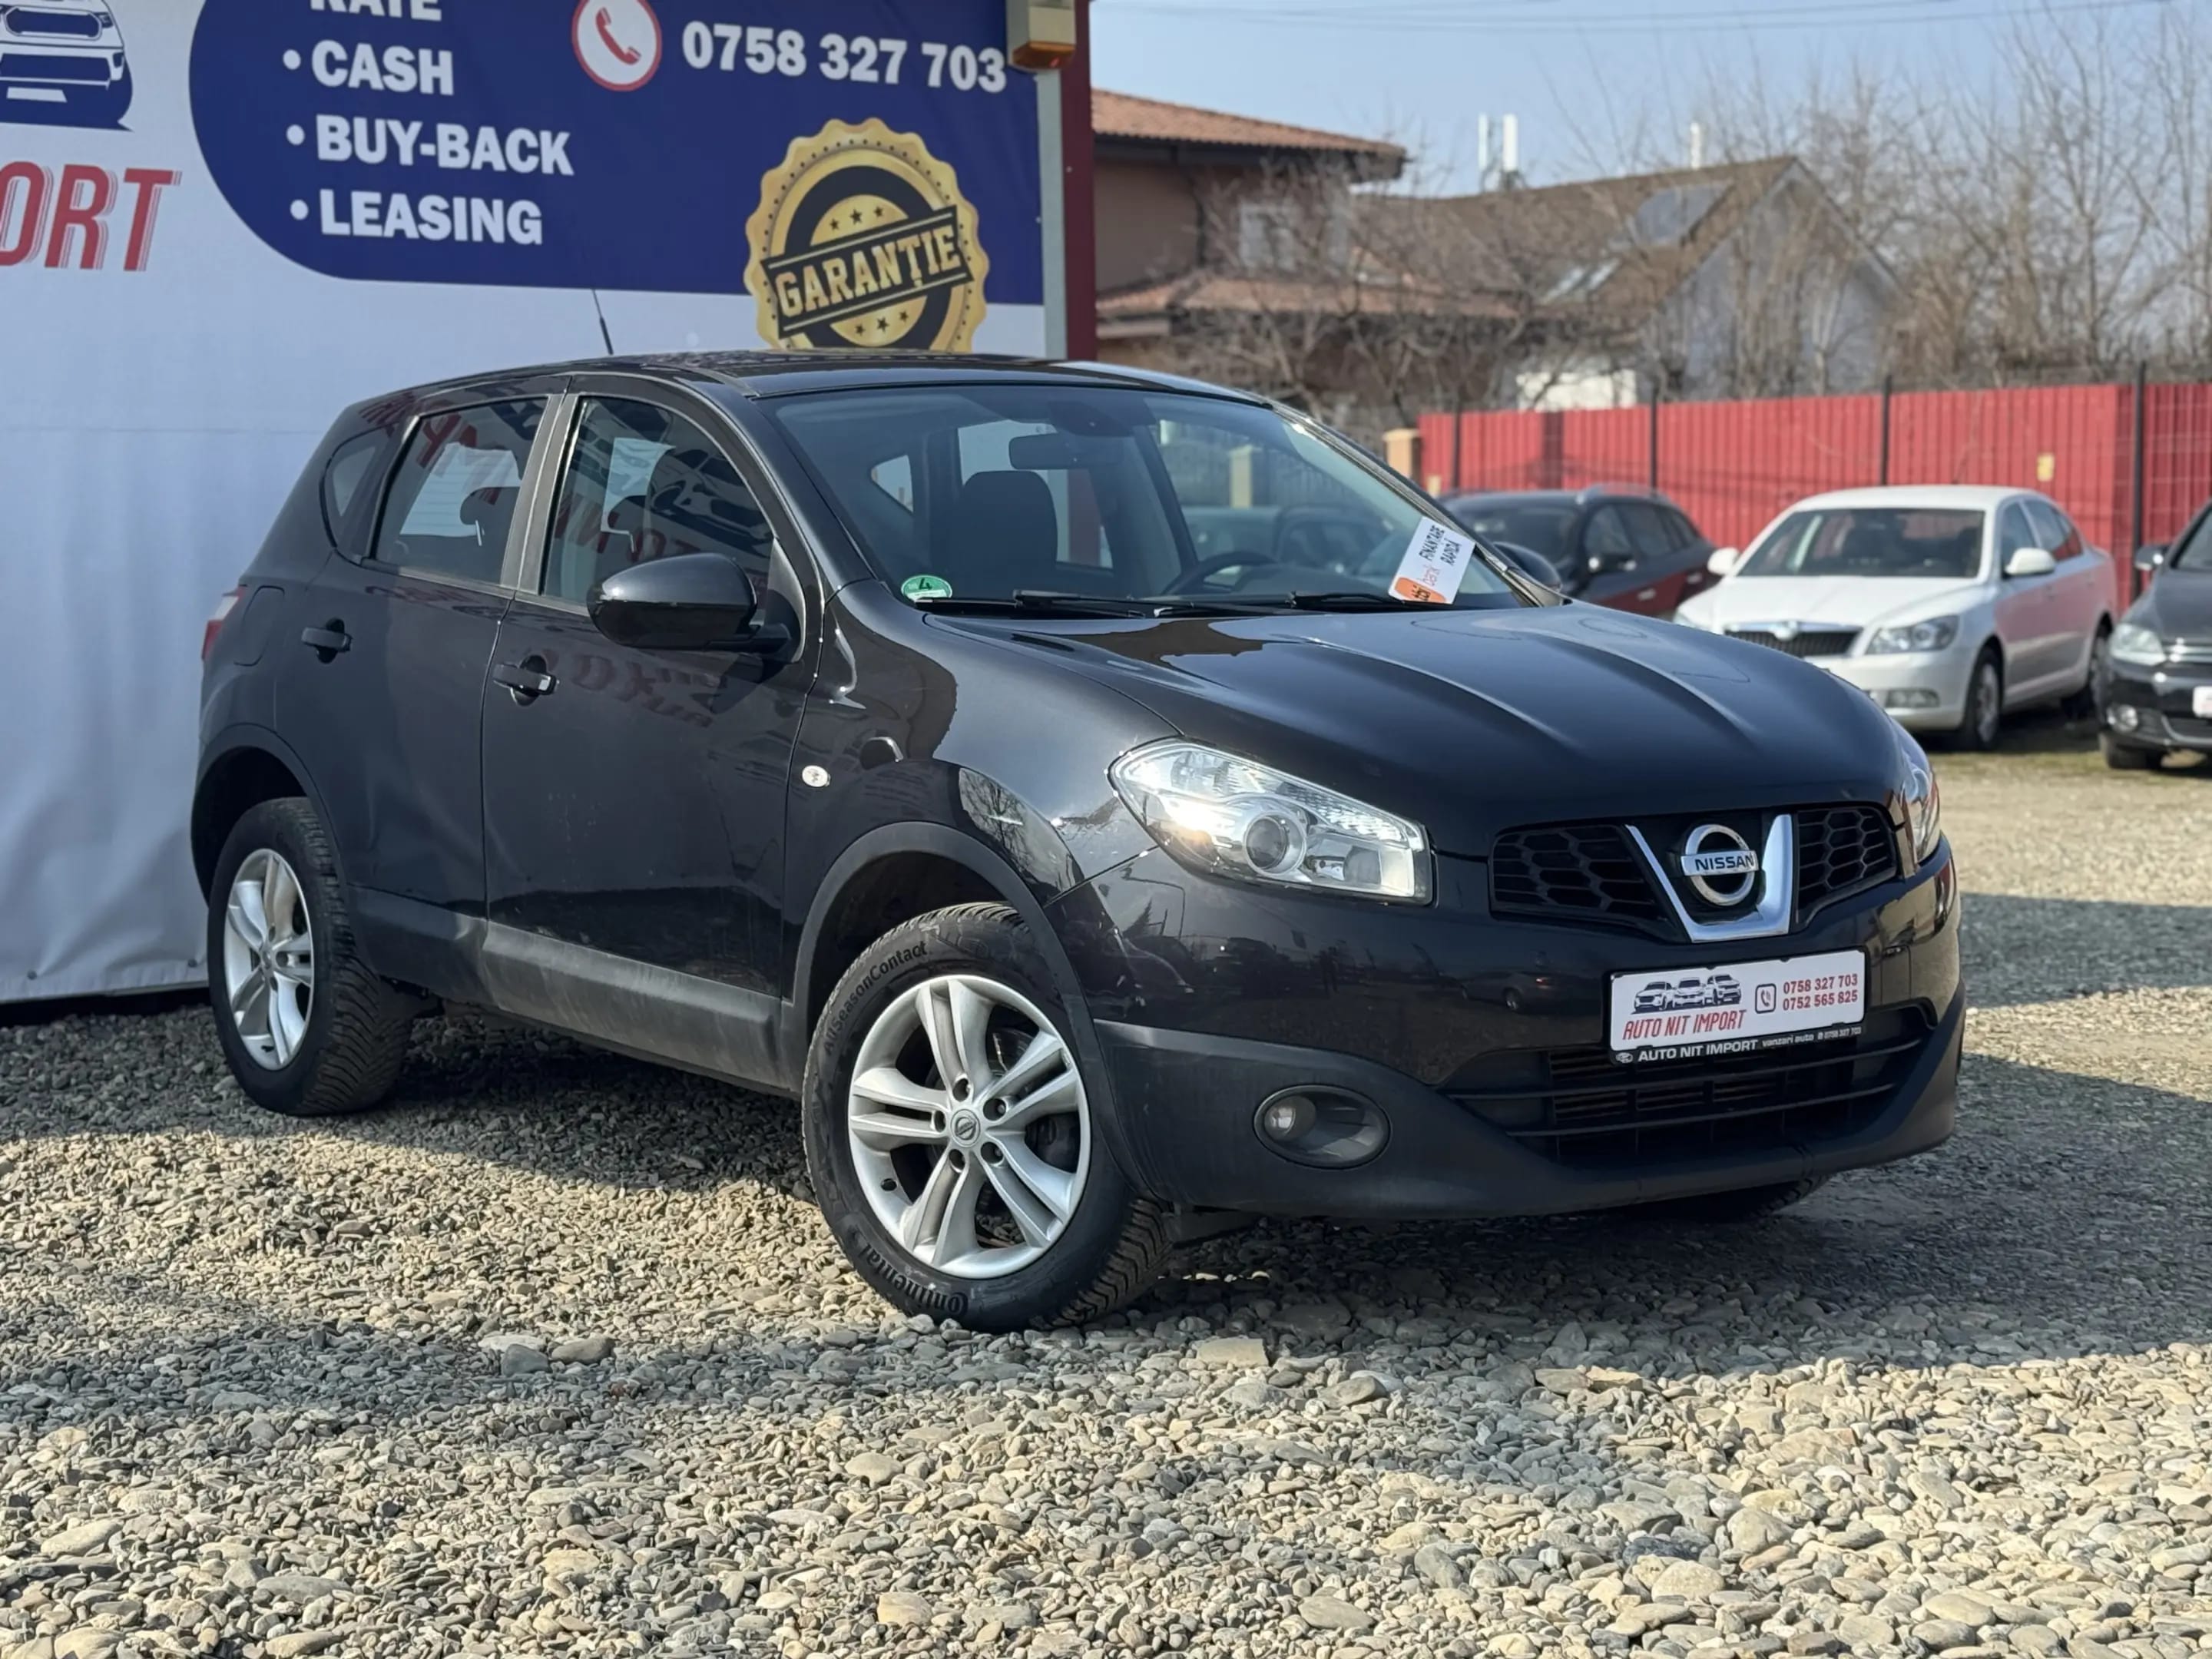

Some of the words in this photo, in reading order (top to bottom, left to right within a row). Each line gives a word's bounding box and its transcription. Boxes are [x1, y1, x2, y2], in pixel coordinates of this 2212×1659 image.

[311, 38, 455, 97] CASH
[682, 20, 807, 77] 0758
[818, 32, 908, 84] 327
[921, 41, 1007, 94] 703
[316, 114, 575, 177] BUY-BACK
[320, 188, 543, 246] LEASING
[919, 578, 932, 591] 4
[1694, 853, 1755, 872] NISSAN
[823, 940, 929, 1057] AllSeasonContact
[1783, 979, 1811, 995] 0758
[1814, 976, 1835, 991] 327
[1838, 973, 1858, 988] 703
[1783, 995, 1811, 1011] 0752
[1814, 992, 1835, 1007] 565
[1837, 989, 1858, 1004] 825
[1622, 1018, 1663, 1041] AUTO
[1664, 1015, 1692, 1037] NIT
[1692, 1009, 1747, 1035] IMPORT
[1637, 1048, 1677, 1062] AUTO
[1680, 1044, 1704, 1058] NIT
[1705, 1039, 1759, 1056] IMPORT
